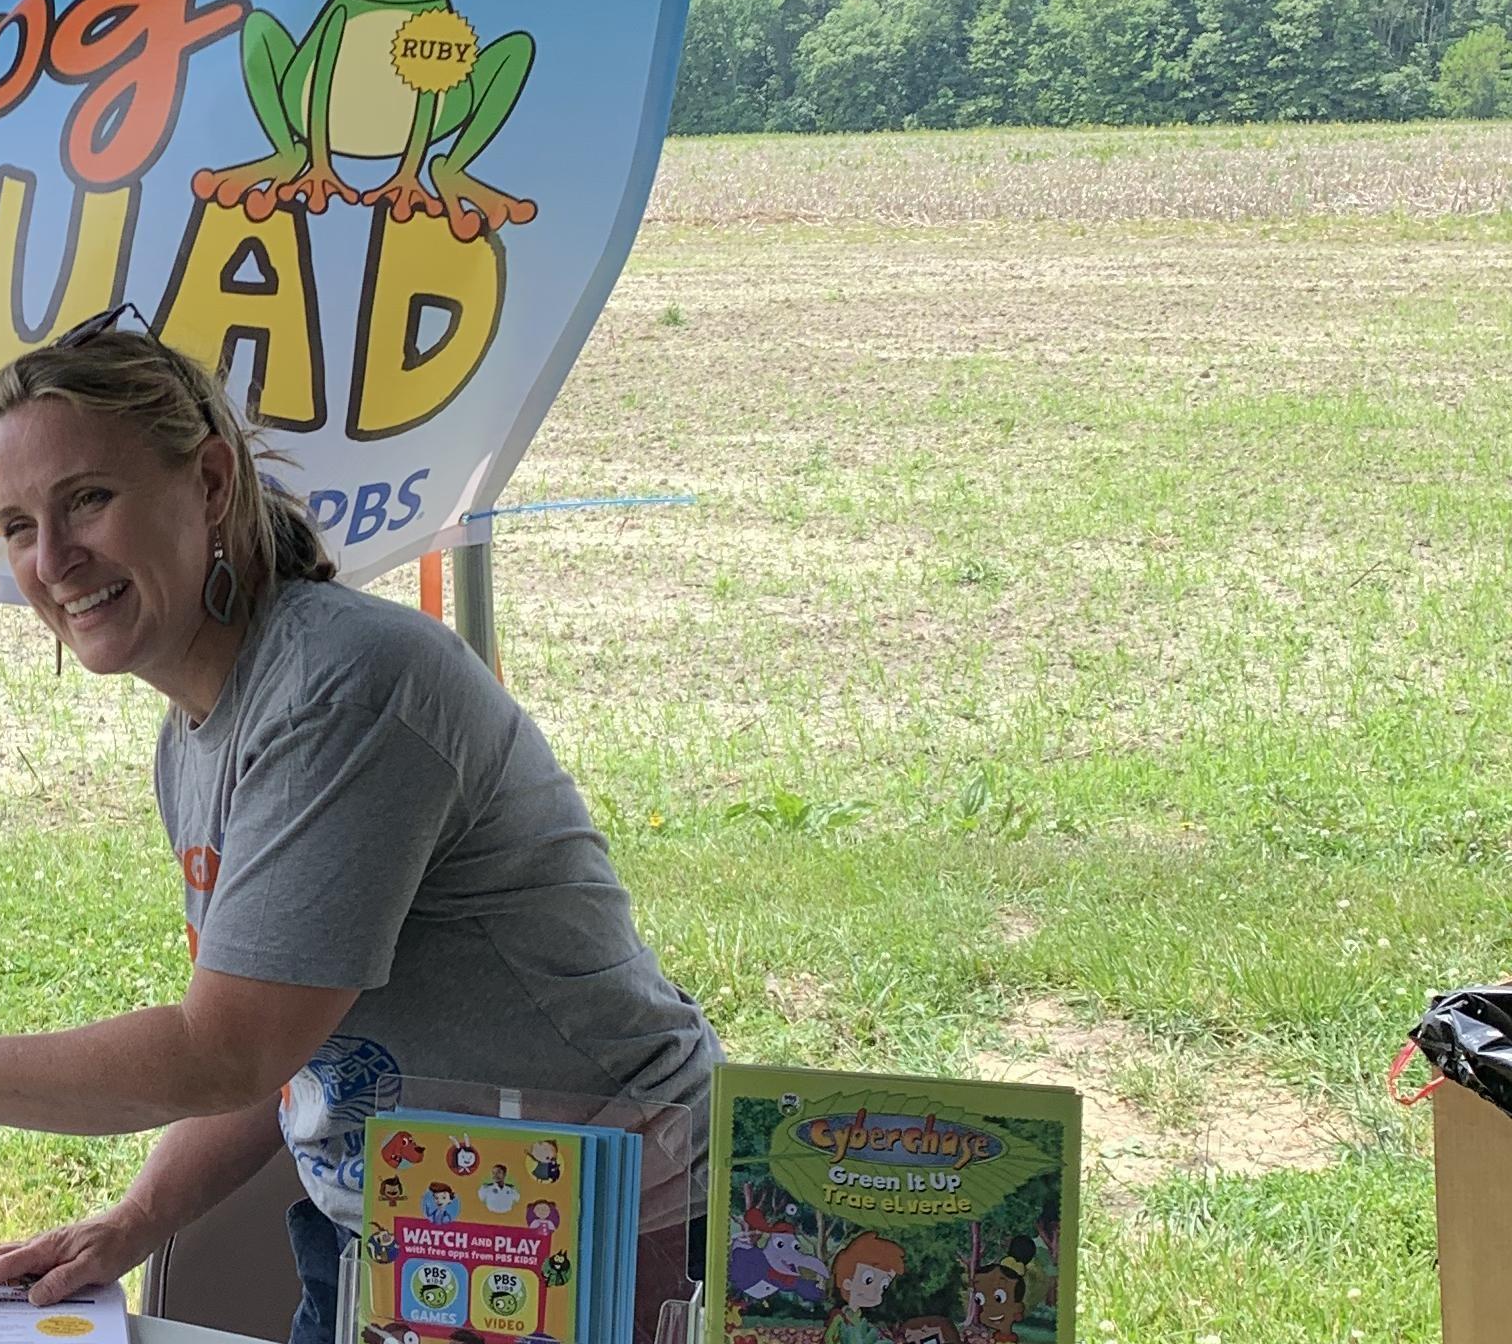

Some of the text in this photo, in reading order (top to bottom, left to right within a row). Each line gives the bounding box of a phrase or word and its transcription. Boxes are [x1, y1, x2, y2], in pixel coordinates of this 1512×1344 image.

[400, 38, 472, 63] RUBY
[305, 468, 431, 547] PBS
[809, 1108, 990, 1170] Cyberchase
[828, 1166, 961, 1193] Green It Up
[822, 1184, 973, 1215] Trae el verde
[402, 1227, 542, 1255] WATCH AND PLAY
[405, 1245, 538, 1266] with free apps from PBS KIDS!
[423, 1267, 447, 1279] PBS
[494, 1274, 517, 1286] PBS
[410, 1309, 457, 1324] GAMES
[484, 1318, 525, 1331] VIDEO
